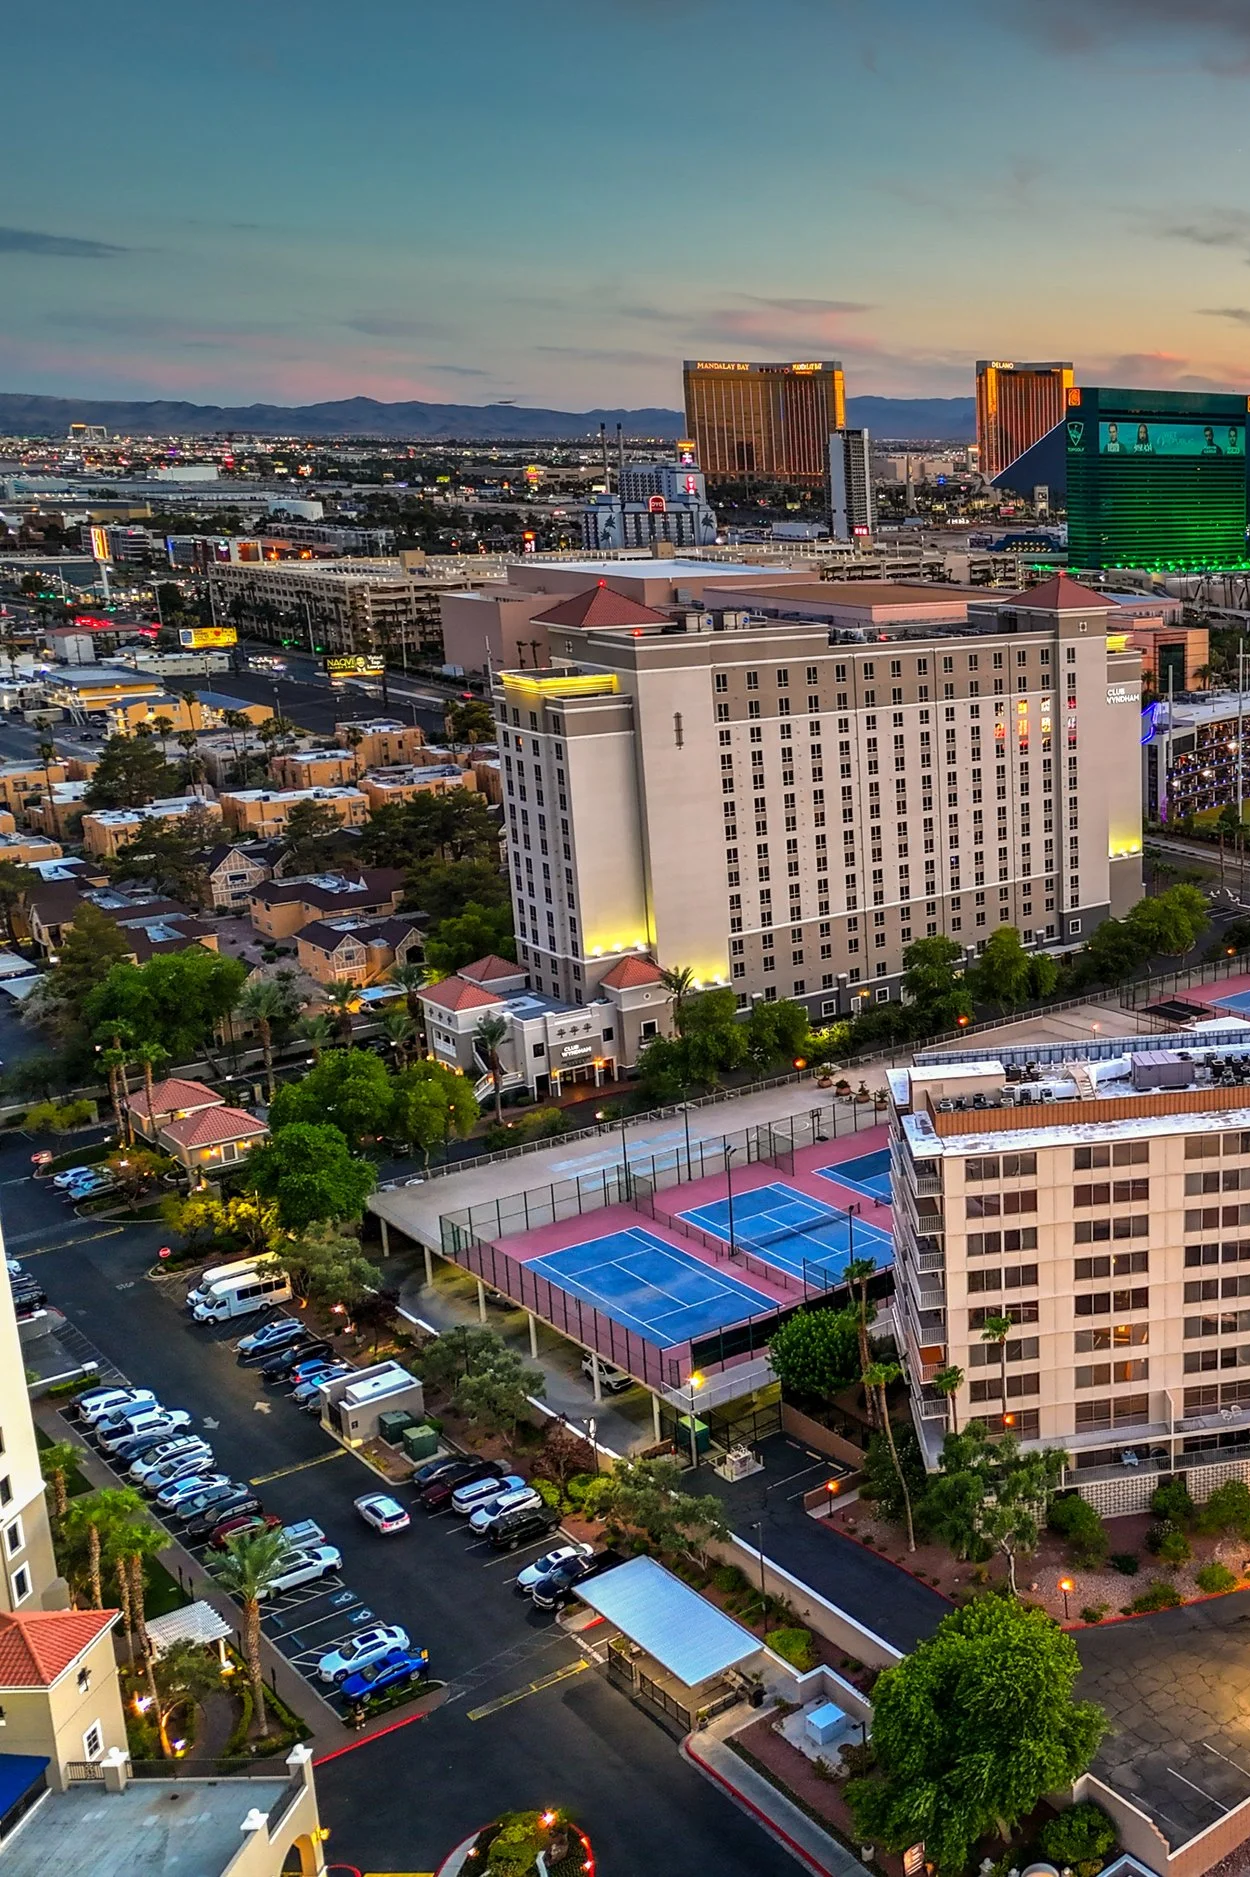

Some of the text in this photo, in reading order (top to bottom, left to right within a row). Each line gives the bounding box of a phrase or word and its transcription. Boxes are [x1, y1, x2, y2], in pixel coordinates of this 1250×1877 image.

[697, 362, 750, 371] MANDALAY BAY
[991, 361, 1014, 369] DELANO
[326, 657, 355, 667] NAQVI
[1107, 687, 1125, 697] CLUB
[563, 1044, 579, 1052] CLUB
